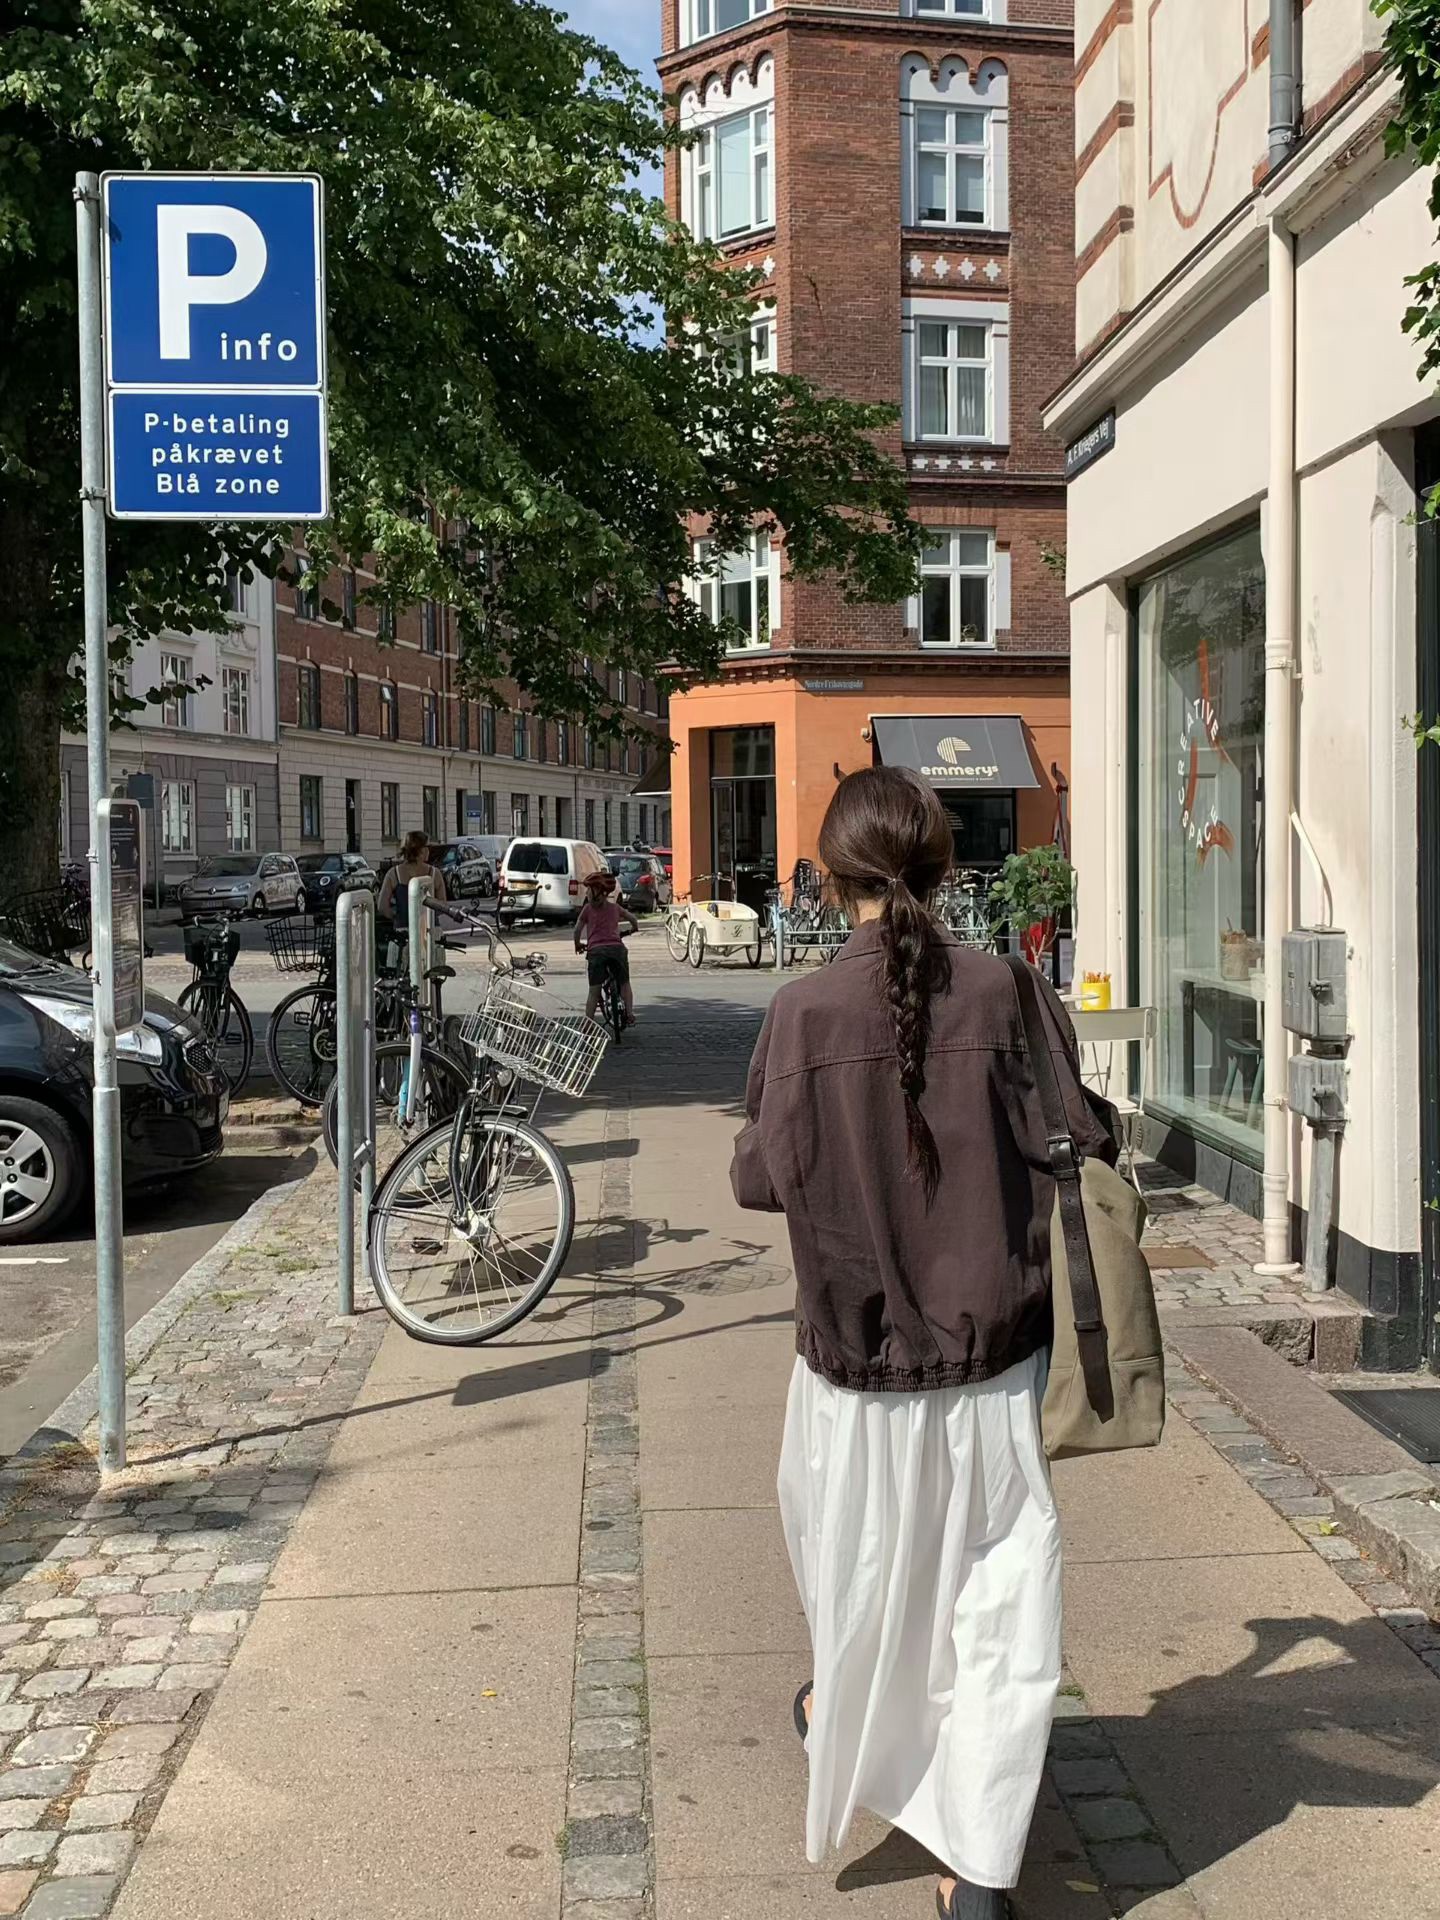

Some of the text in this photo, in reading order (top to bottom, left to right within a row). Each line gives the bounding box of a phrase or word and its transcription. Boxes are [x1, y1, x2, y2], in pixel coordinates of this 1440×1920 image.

[157, 205, 267, 360] P
[220, 333, 297, 360] info
[145, 413, 289, 438] P-betaling
[1099, 418, 1109, 439] Vej
[152, 444, 283, 466] påkrævet
[157, 473, 280, 494] Blå zone
[920, 765, 999, 777] emmerys
[1178, 698, 1219, 848] CREATIVE SPACE
